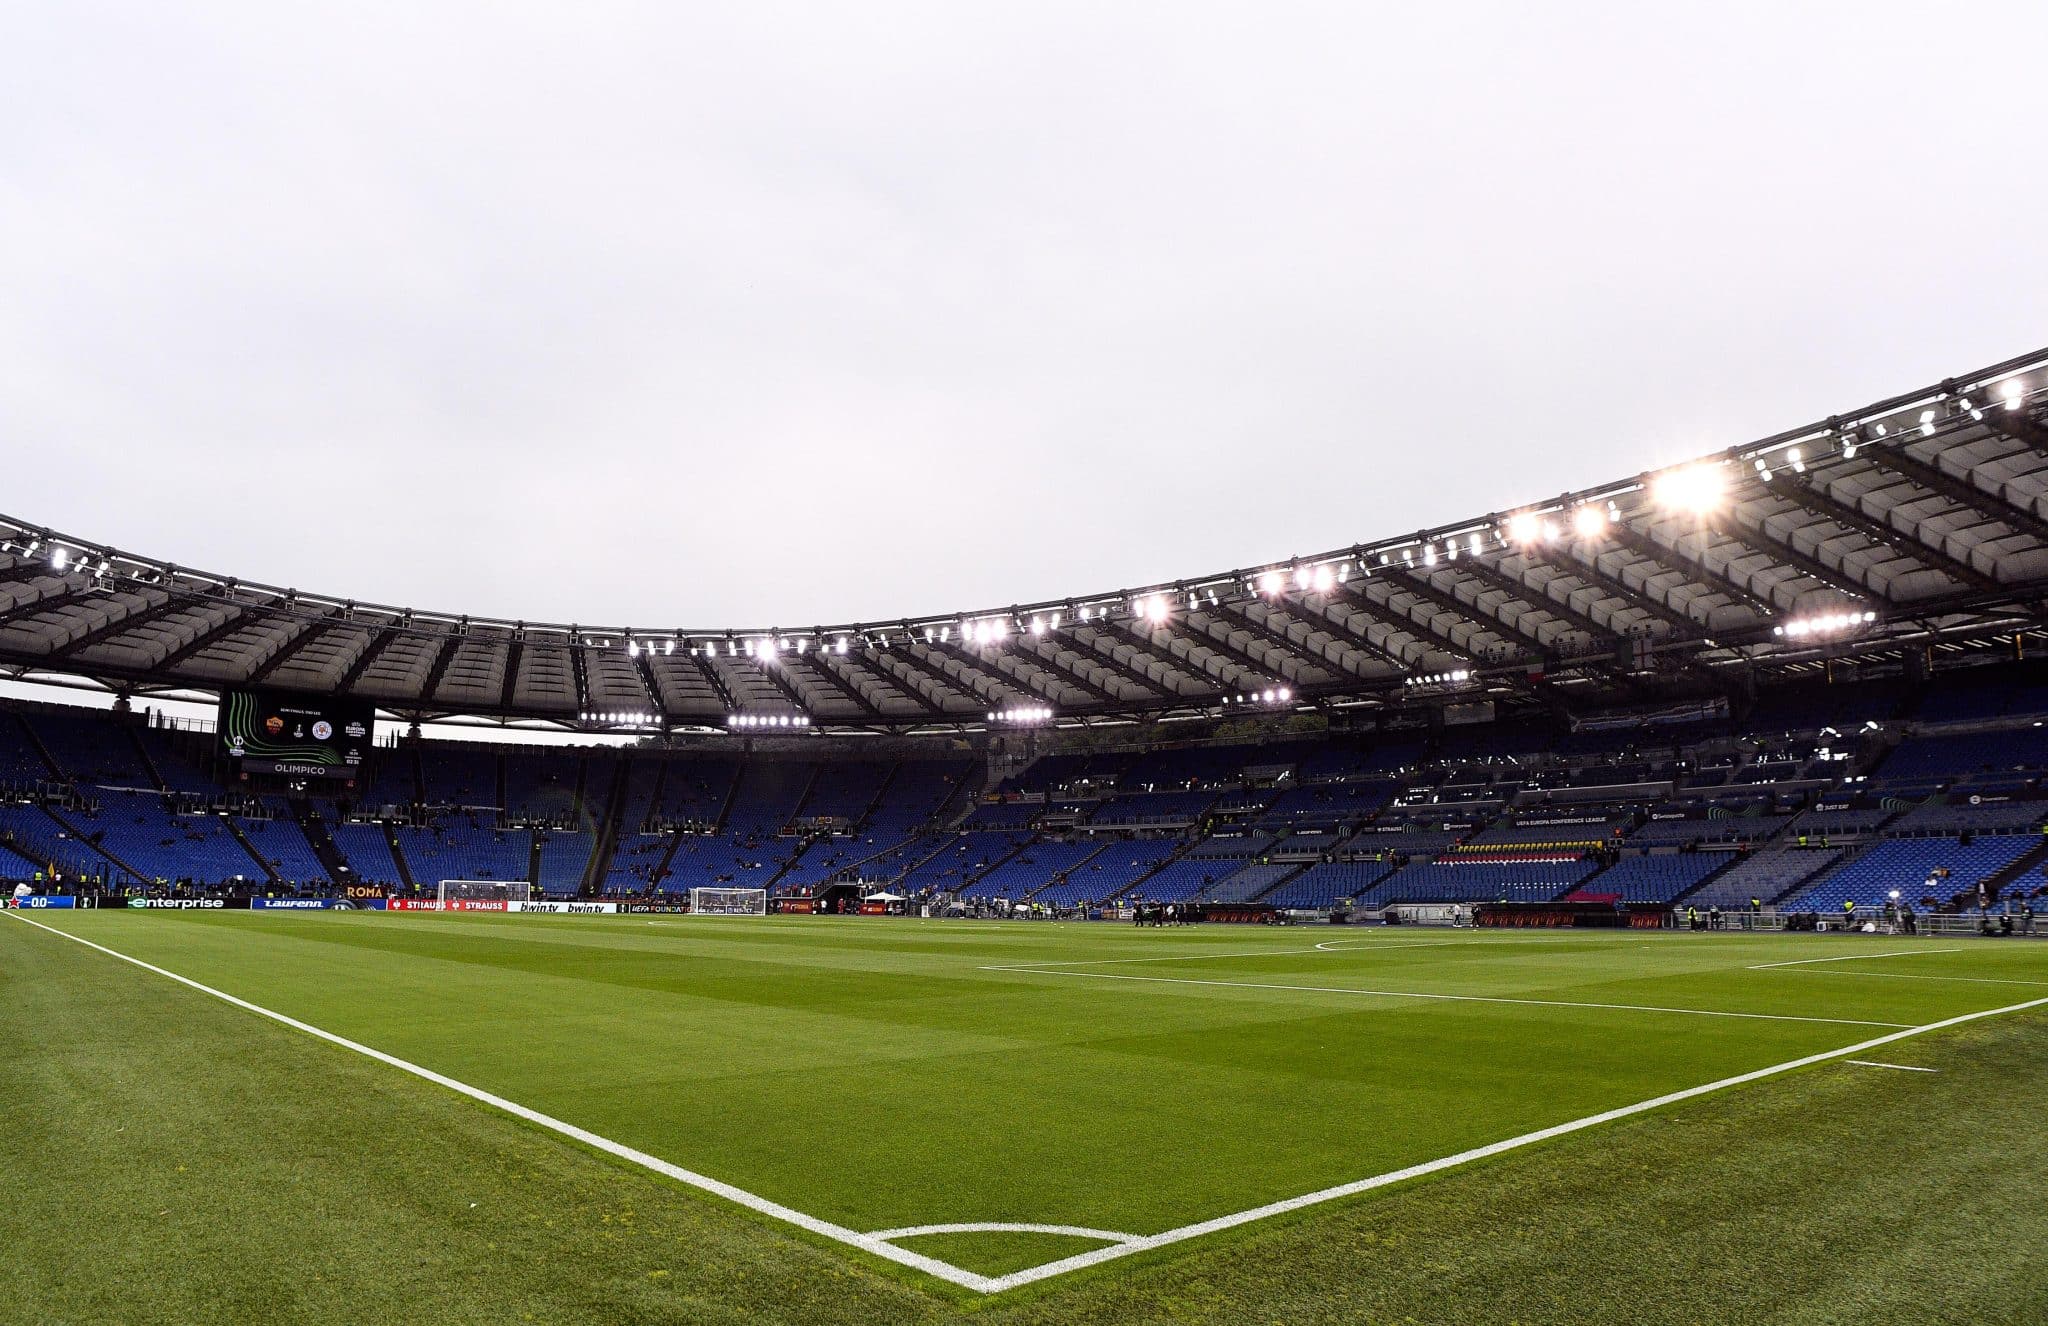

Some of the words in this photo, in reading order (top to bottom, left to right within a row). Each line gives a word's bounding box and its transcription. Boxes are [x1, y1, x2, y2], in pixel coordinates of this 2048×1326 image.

[274, 764, 325, 775] OLIMPICO
[347, 886, 383, 898] ROMA
[128, 897, 224, 910] enterprise
[465, 902, 503, 910] STRAUSS
[520, 902, 559, 912] bwin.tv
[567, 903, 604, 913] bwin.tv
[650, 905, 697, 913] FOUNDATIO
